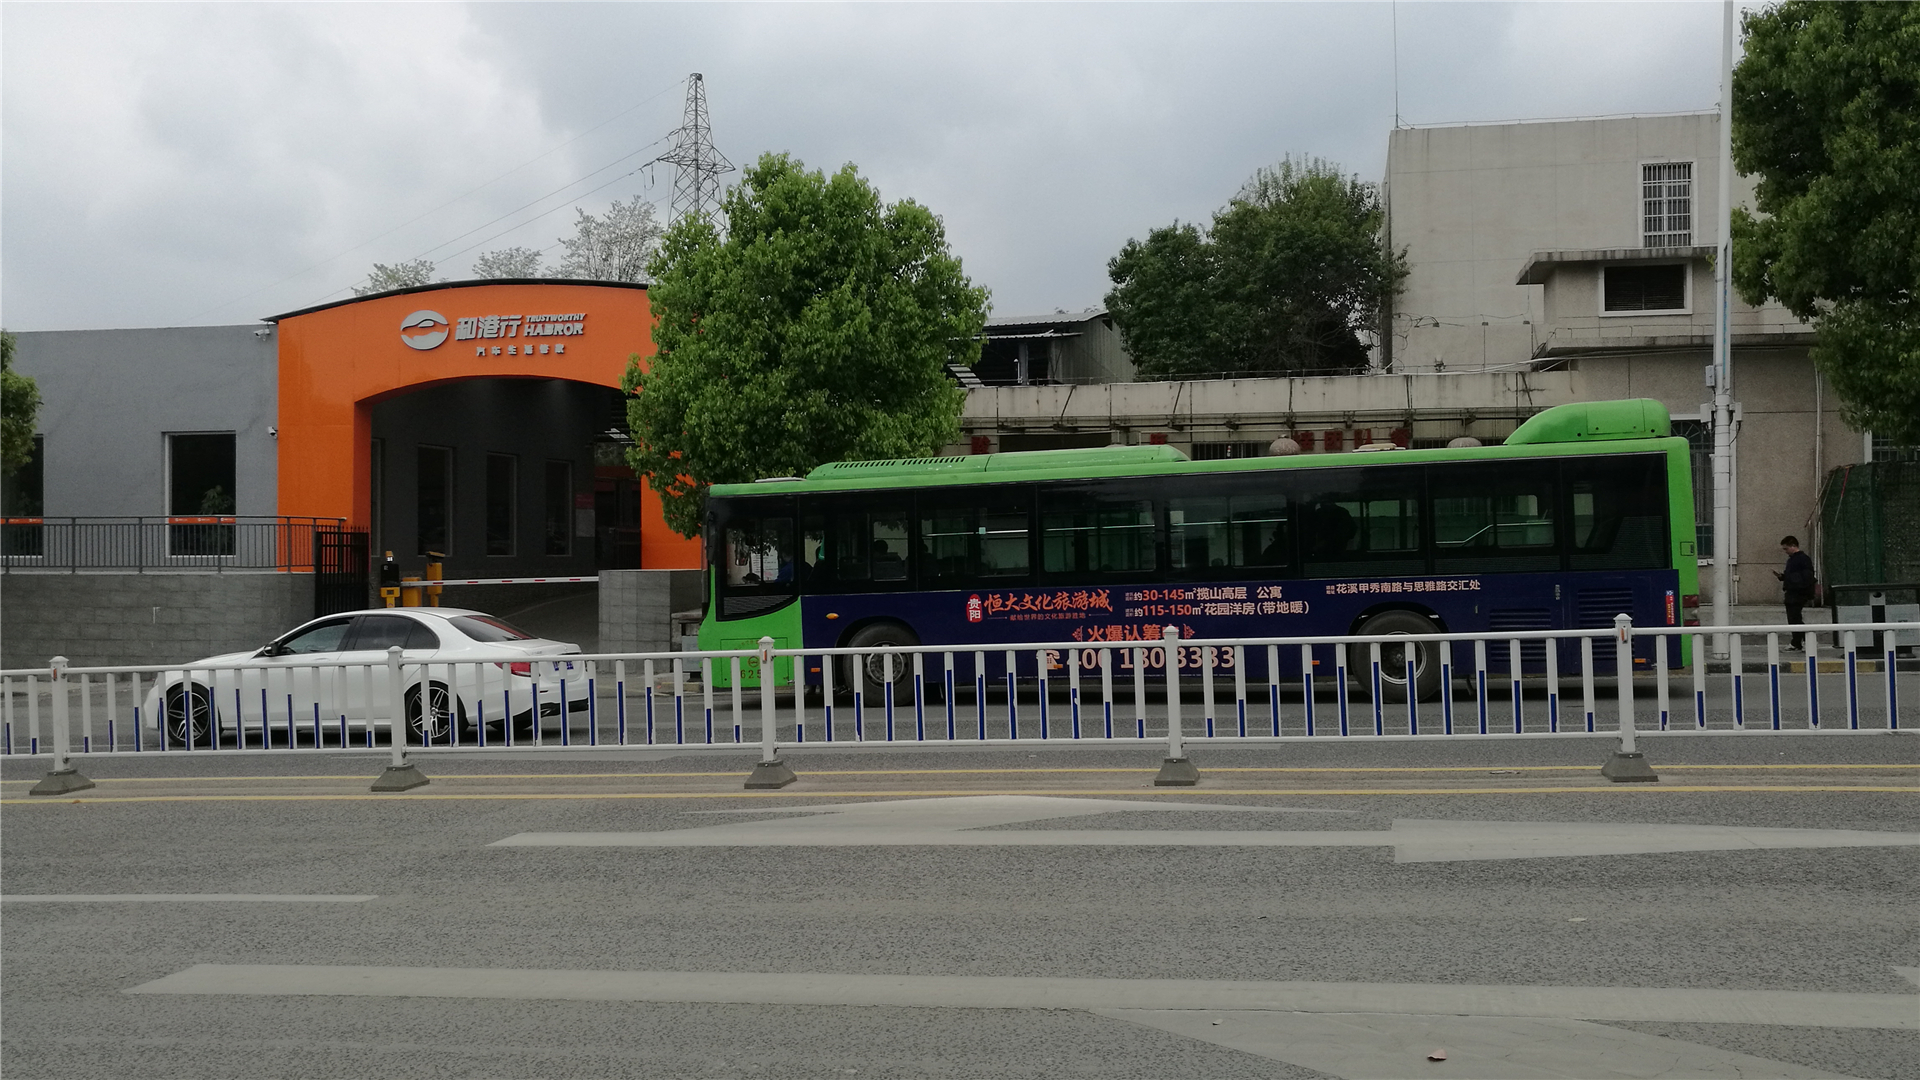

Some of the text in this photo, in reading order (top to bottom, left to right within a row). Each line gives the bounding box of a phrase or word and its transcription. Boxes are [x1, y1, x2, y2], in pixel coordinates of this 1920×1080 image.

[526, 313, 587, 323] TRUSTWORTHY
[455, 314, 522, 340] 和港行
[524, 323, 584, 336] HABROR
[1256, 586, 1283, 600] 公寓
[1335, 580, 1482, 594] 花溪甲秀南路与思雅路交汇处
[967, 598, 981, 621] 贵阳
[983, 589, 1113, 615] 恒大文化旅游城
[1087, 623, 1179, 642] 火爆认筹
